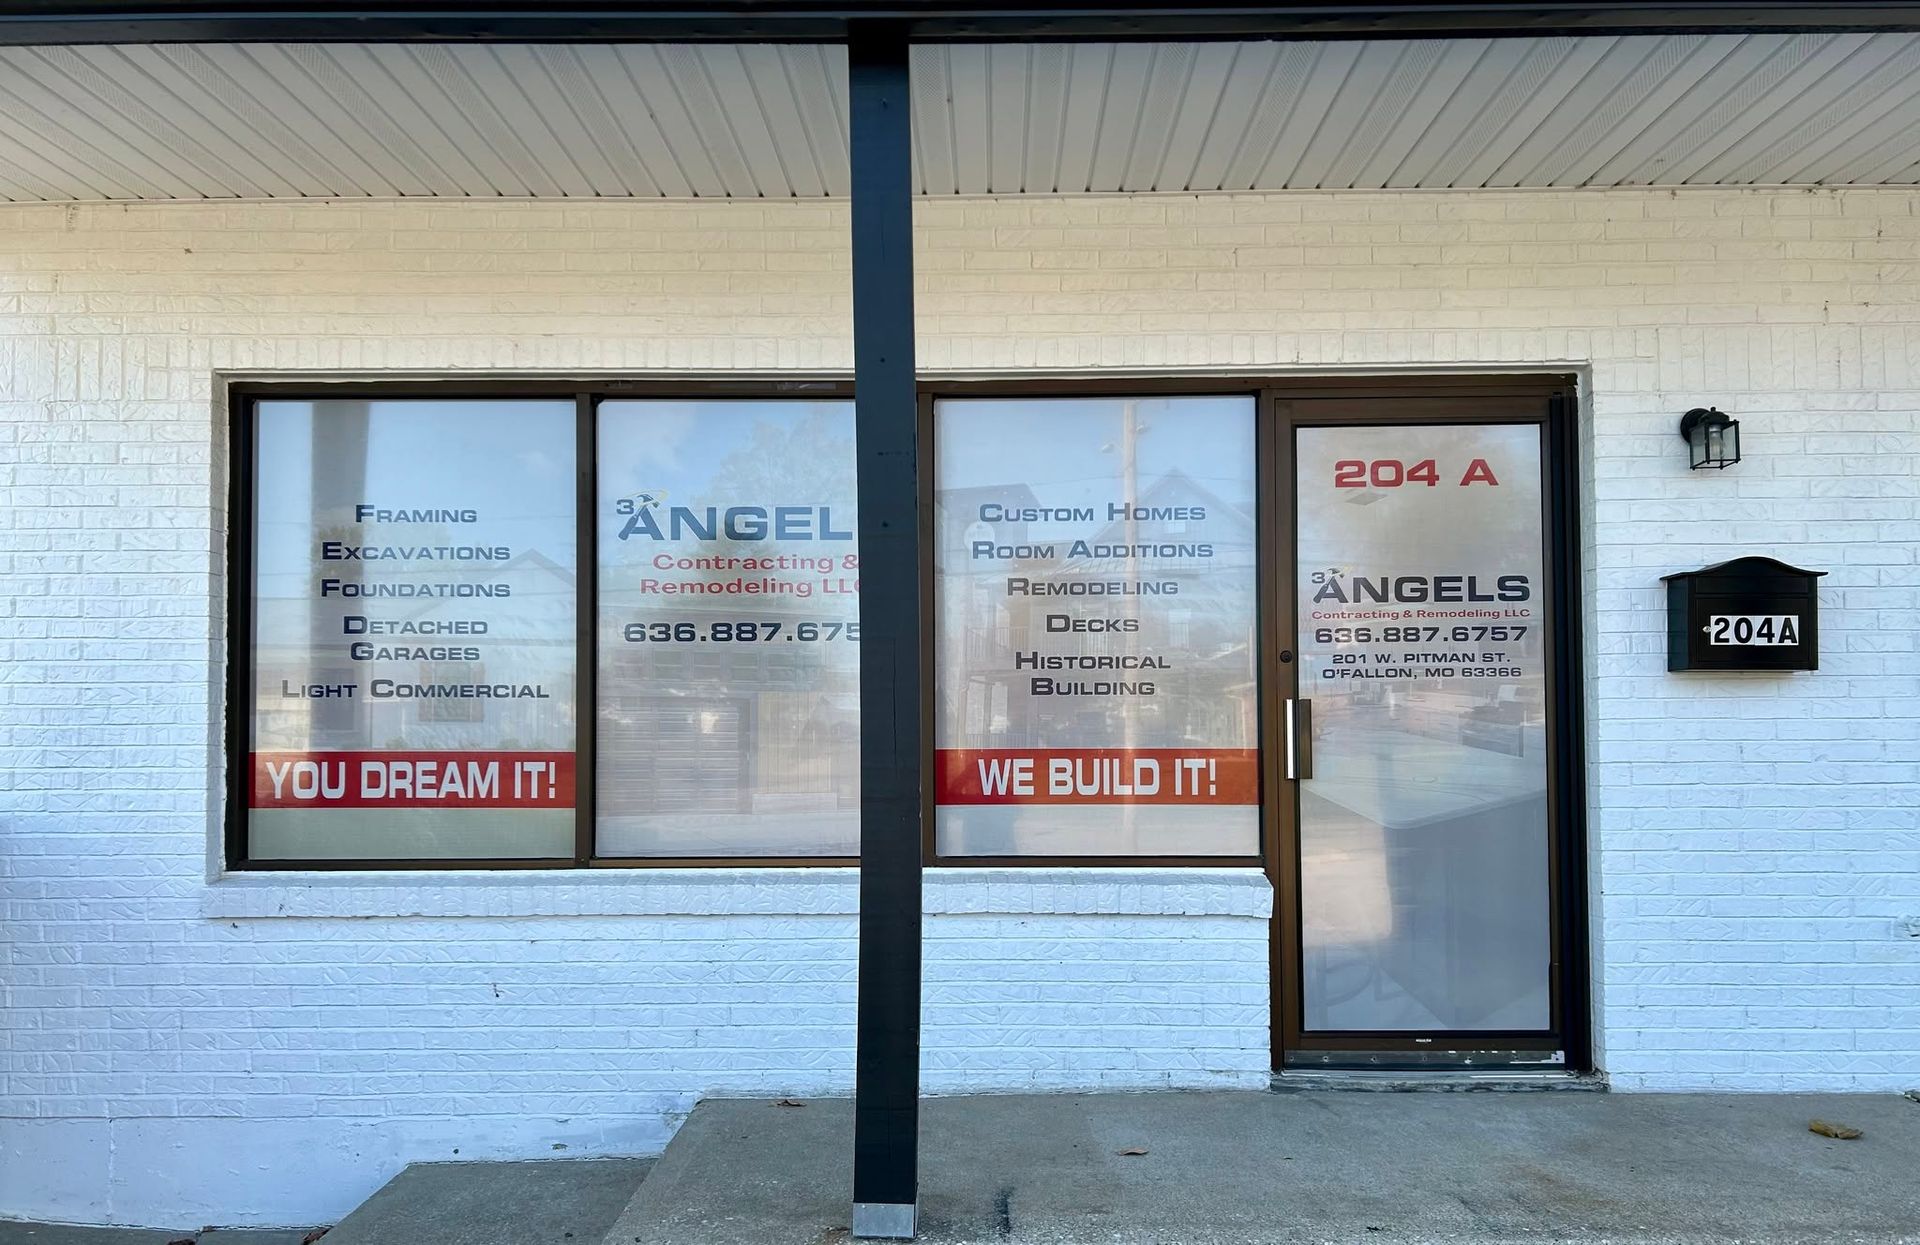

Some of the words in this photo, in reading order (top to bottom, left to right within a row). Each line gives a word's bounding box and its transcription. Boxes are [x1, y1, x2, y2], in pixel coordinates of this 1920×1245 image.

[1335, 459, 1440, 488] 204
[1459, 458, 1499, 486] A
[355, 504, 477, 523] FRAMING
[616, 498, 635, 515] 3
[979, 503, 1094, 522] CUSTOM
[1107, 502, 1206, 521] HOMES
[618, 503, 853, 541] ANGEL
[322, 541, 511, 560] EXCAVATIONS
[972, 540, 1055, 560] ROOM
[1067, 540, 1213, 559] ADDITIONS
[653, 554, 834, 573] Contracting
[841, 554, 860, 570] &
[321, 578, 511, 597] FOUNDATIONS
[640, 578, 812, 598] Remodeling
[1007, 577, 1179, 596] REMODELING
[1313, 574, 1530, 604] ANGELS
[1046, 614, 1140, 633] DECKS
[1311, 611, 1399, 621] Contracting
[1402, 609, 1413, 618] &
[1416, 609, 1500, 619] Remodeling
[1504, 609, 1530, 618] LLC
[343, 615, 488, 635] DETACHED
[624, 622, 860, 642] 636.887.675
[1315, 626, 1528, 643] 636.887.6757
[1714, 617, 1798, 644] 204A
[350, 641, 480, 661] GARAGES
[1015, 651, 1171, 670] HISTORICAL
[1332, 654, 1366, 664] 201
[1375, 653, 1396, 664] W.
[1403, 653, 1475, 663] PITMAN
[1482, 652, 1511, 663] ST.
[1322, 667, 1418, 680] O'FALLON,
[1425, 667, 1455, 678] MO
[1461, 667, 1522, 678] 63366
[282, 679, 357, 698] LIGHT
[370, 679, 549, 698] COMMERCIAL
[1031, 677, 1155, 696] BUILDING
[265, 761, 346, 799] YOU
[360, 761, 499, 799] DREAM
[514, 761, 556, 799] IT!
[977, 758, 1034, 796] WE
[1049, 758, 1160, 796] BUILD
[1174, 758, 1217, 796] IT!
